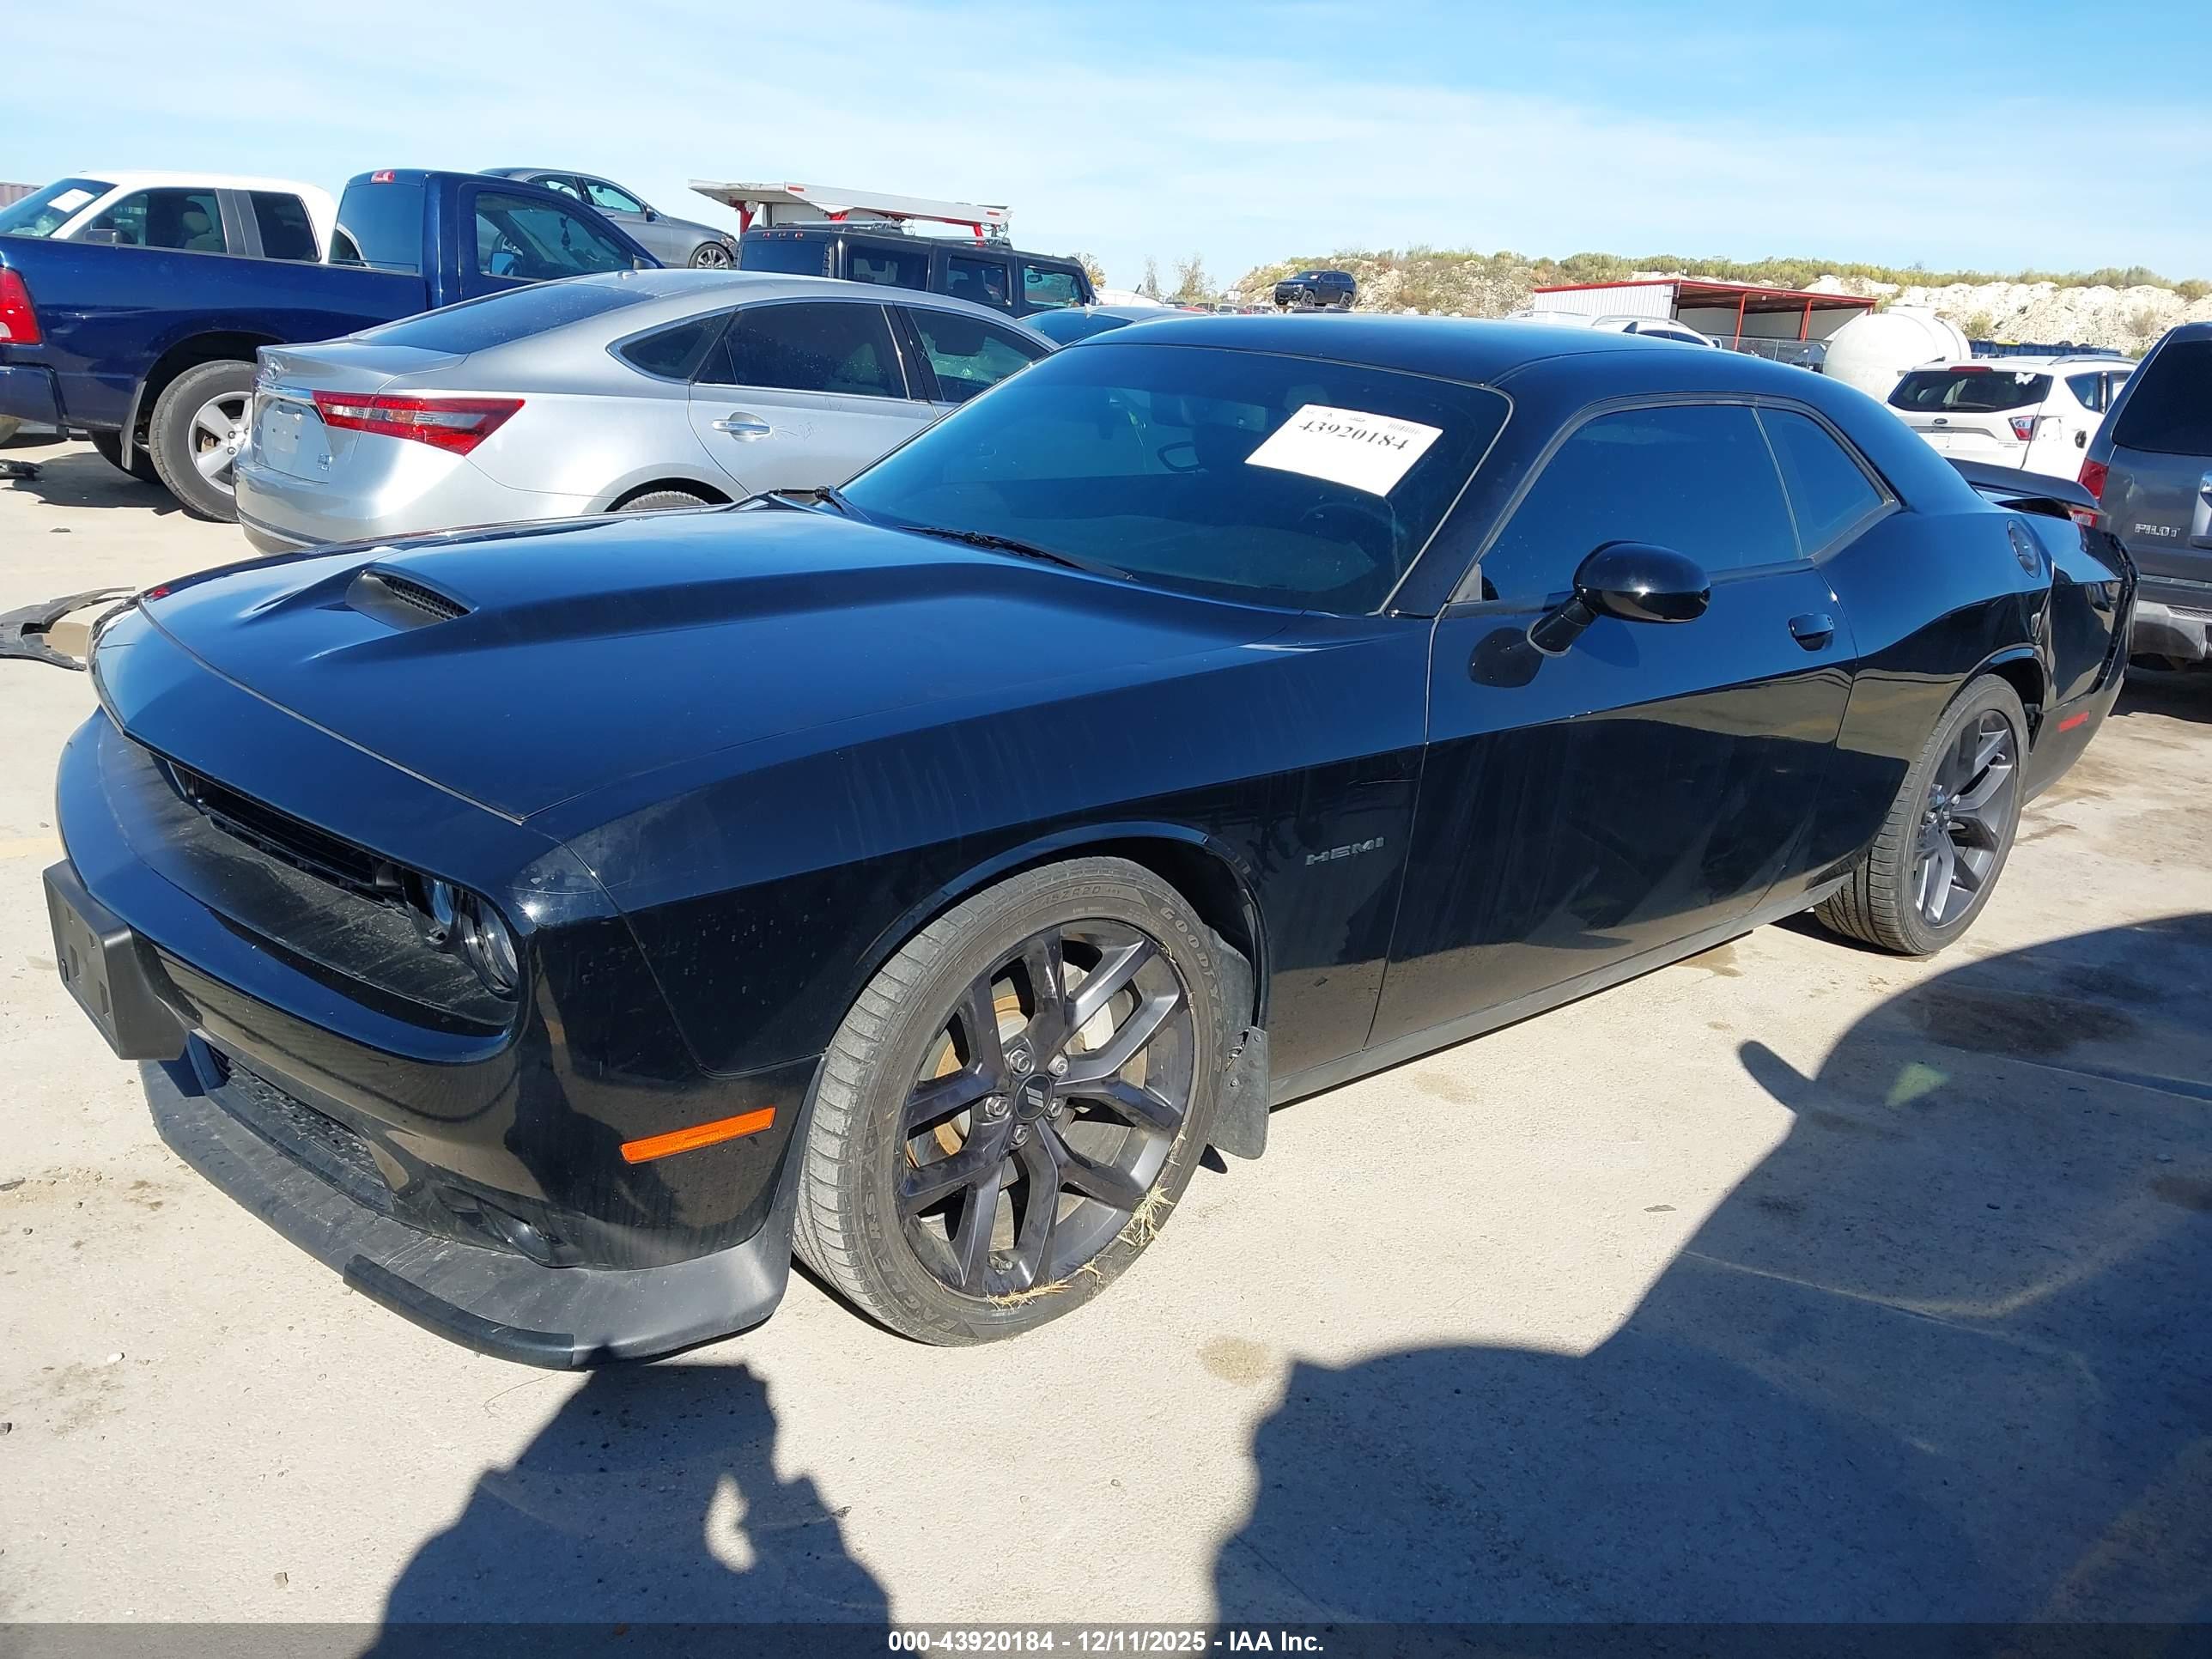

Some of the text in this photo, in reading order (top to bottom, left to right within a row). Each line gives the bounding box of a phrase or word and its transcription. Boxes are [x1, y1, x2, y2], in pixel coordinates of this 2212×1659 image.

[1298, 420, 1409, 451] 43920184
[2135, 523, 2181, 538] PILOT
[1305, 836, 1384, 866] HEMI
[1160, 906, 1223, 1073] GOODYEAR
